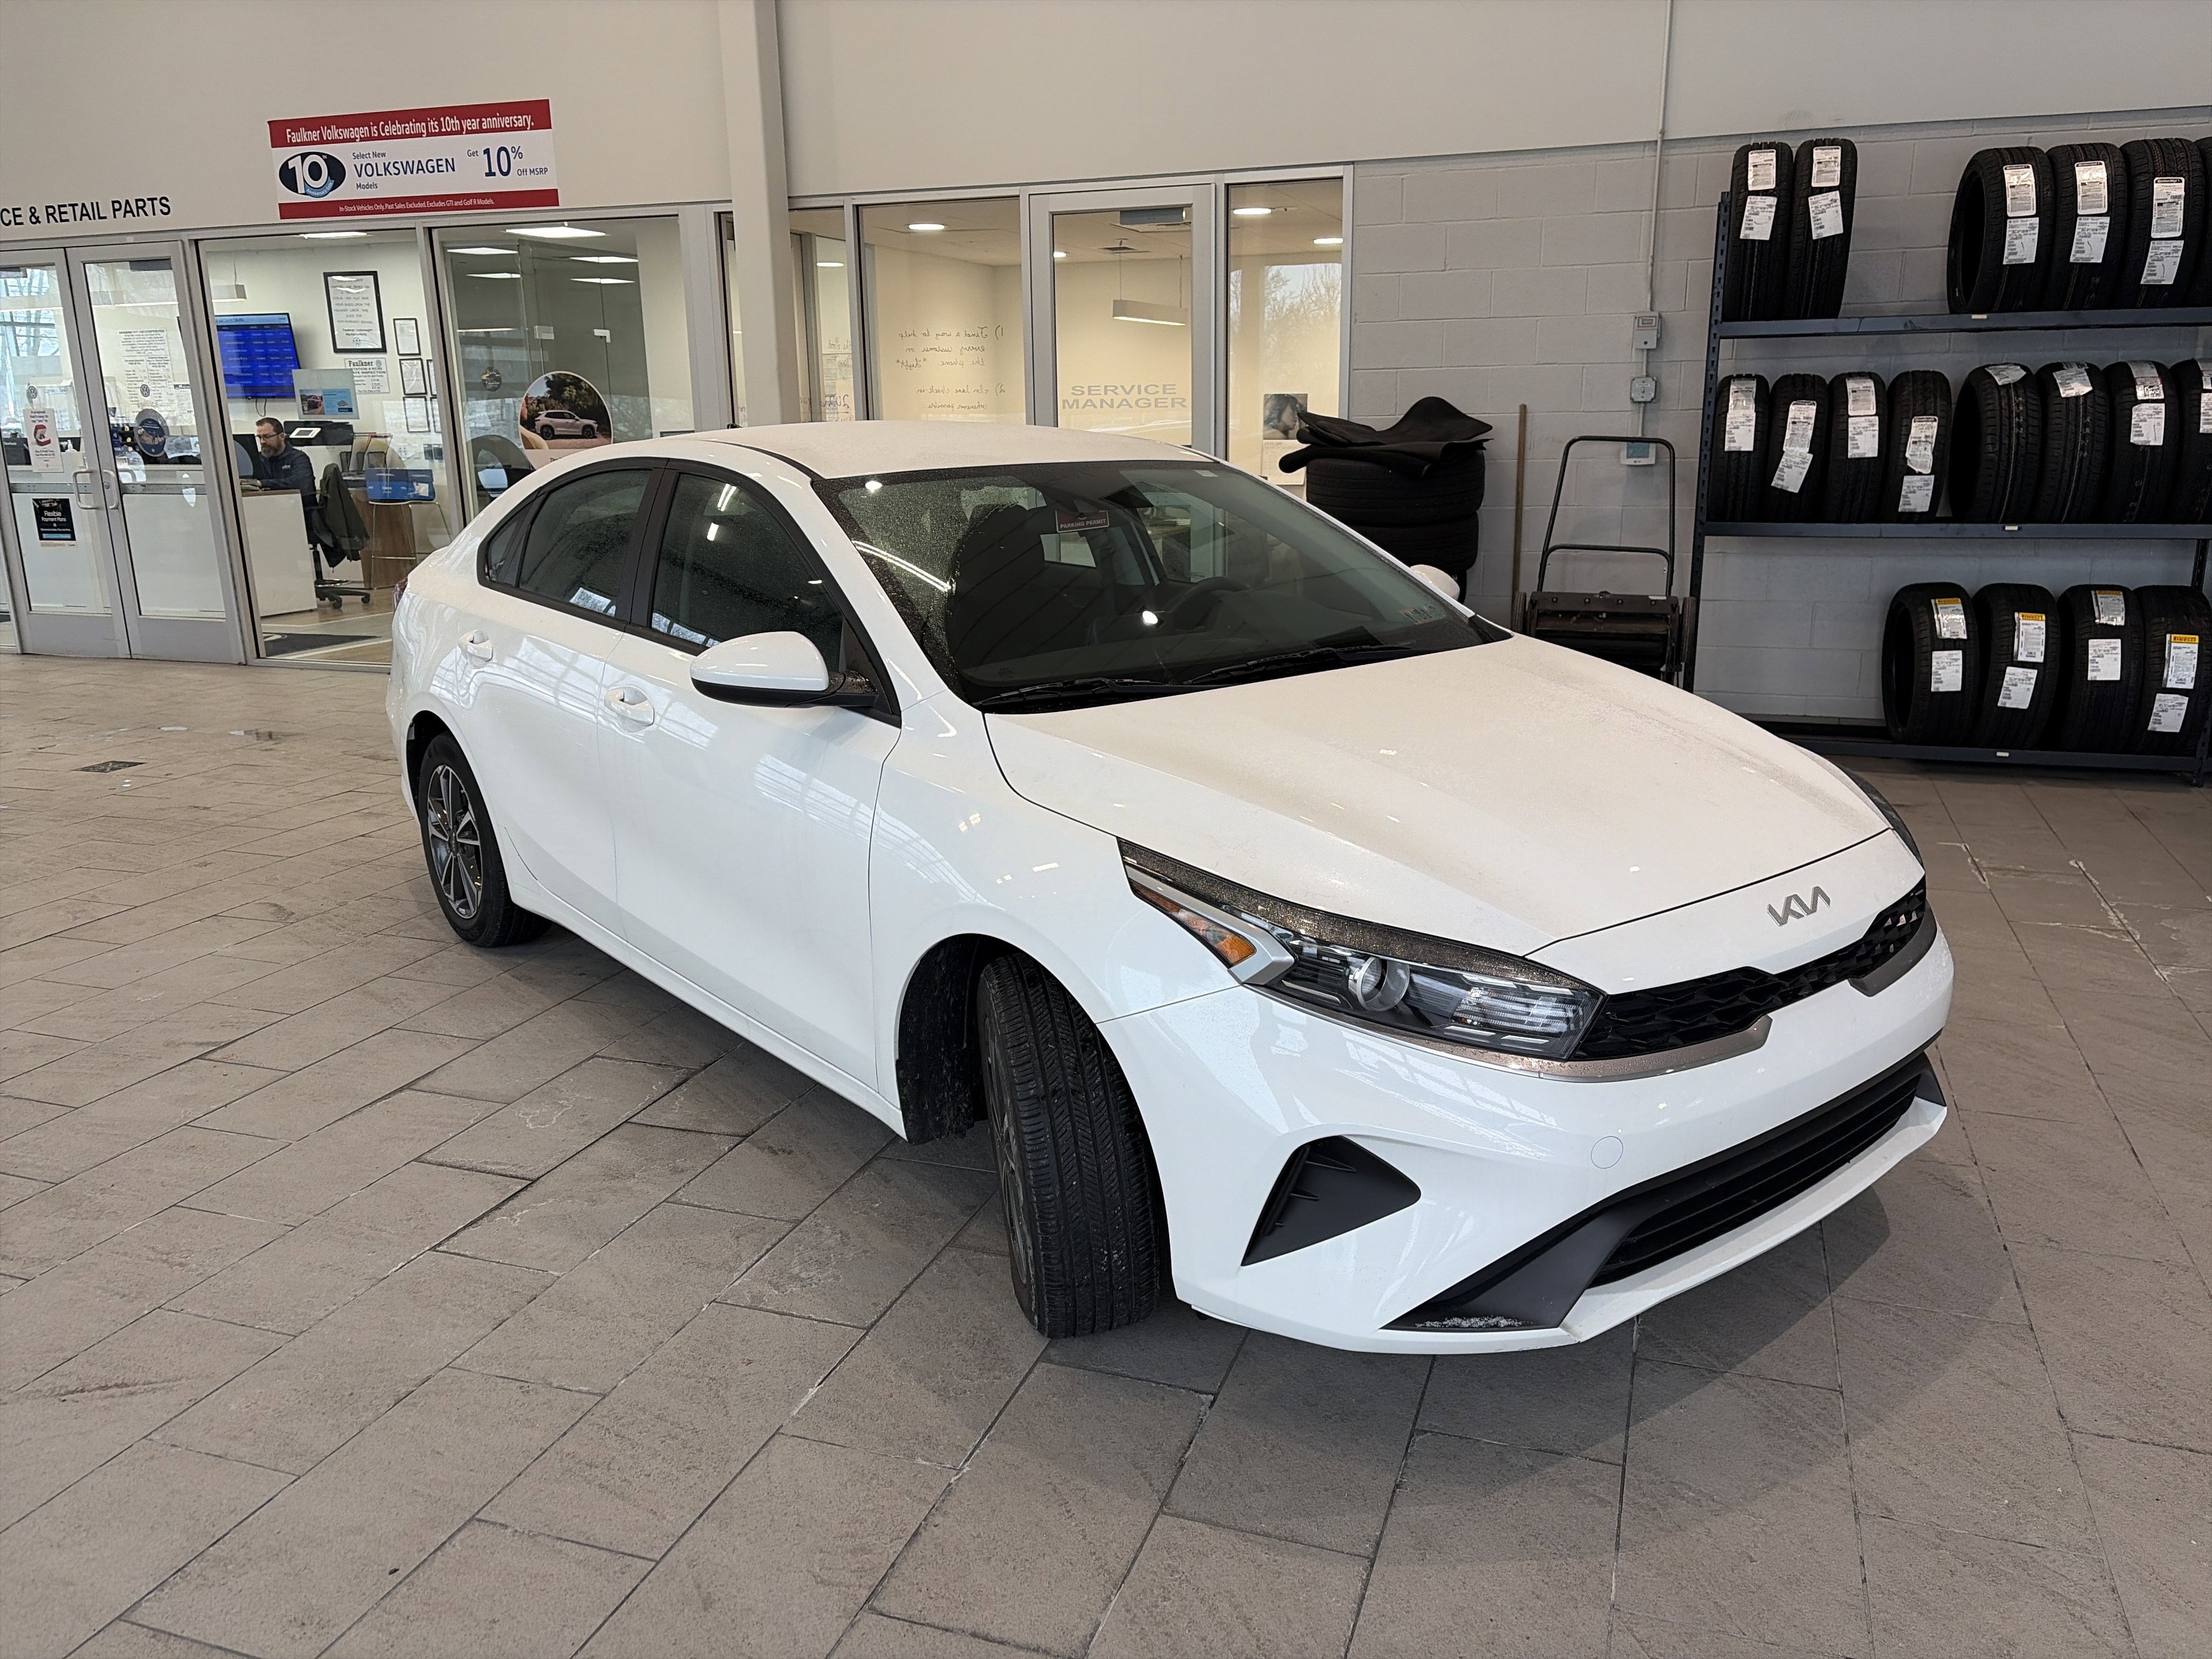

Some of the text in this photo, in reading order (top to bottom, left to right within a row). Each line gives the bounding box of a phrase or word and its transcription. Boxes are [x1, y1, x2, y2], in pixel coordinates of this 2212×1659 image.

[286, 112, 534, 143] Faulkner Volkswagen is Celebrating it's 10th year anniversary.
[352, 151, 371, 160] Select
[467, 149, 479, 157] Get
[354, 157, 456, 178] VOLKSWAGEN
[517, 167, 548, 176] Off MSRP
[287, 154, 329, 194] 10
[29, 206, 41, 224] &
[45, 201, 107, 224] RETAIL
[111, 196, 171, 218] PARTS
[1070, 384, 1177, 396] SERVICE
[1062, 397, 1188, 409] MANAGER
